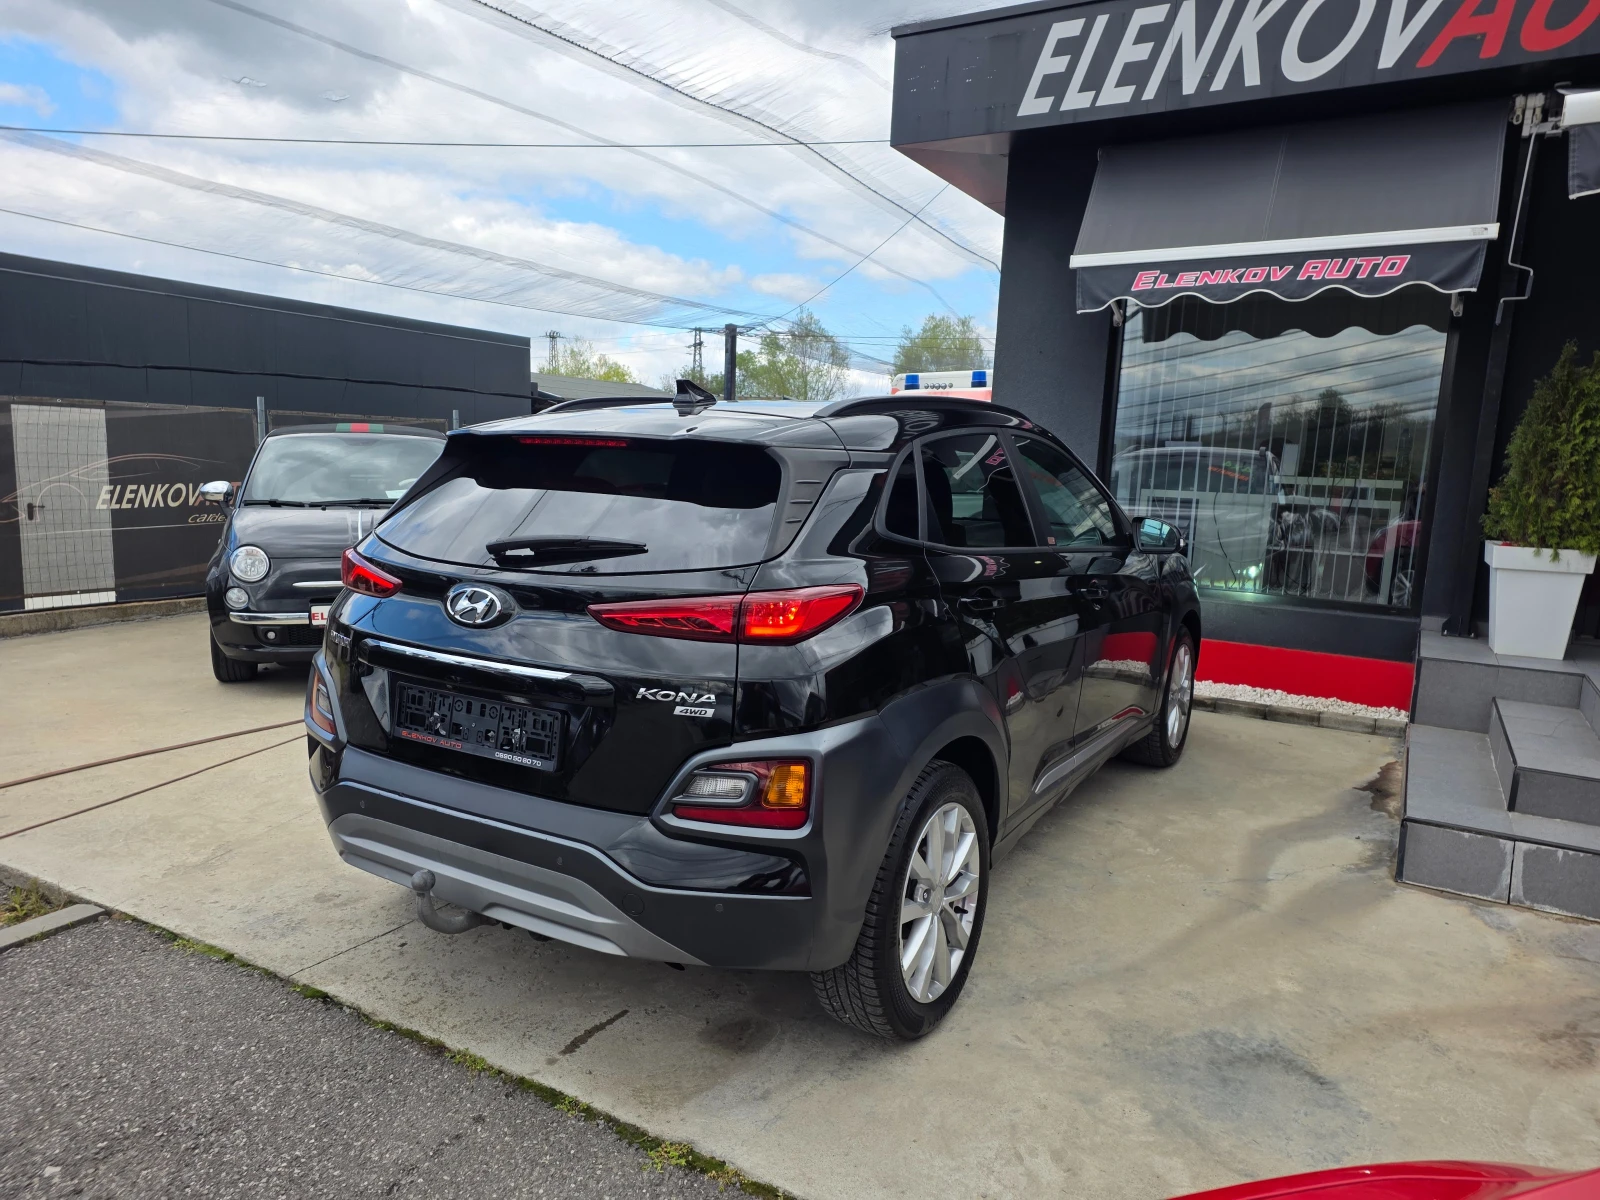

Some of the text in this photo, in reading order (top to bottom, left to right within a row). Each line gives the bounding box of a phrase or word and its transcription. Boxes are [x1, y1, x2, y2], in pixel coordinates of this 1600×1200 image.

[1131, 255, 1411, 291] ELENKOV AUTO
[635, 687, 717, 705] KONA
[679, 708, 708, 716] 4WD
[440, 740, 462, 749] AUTO
